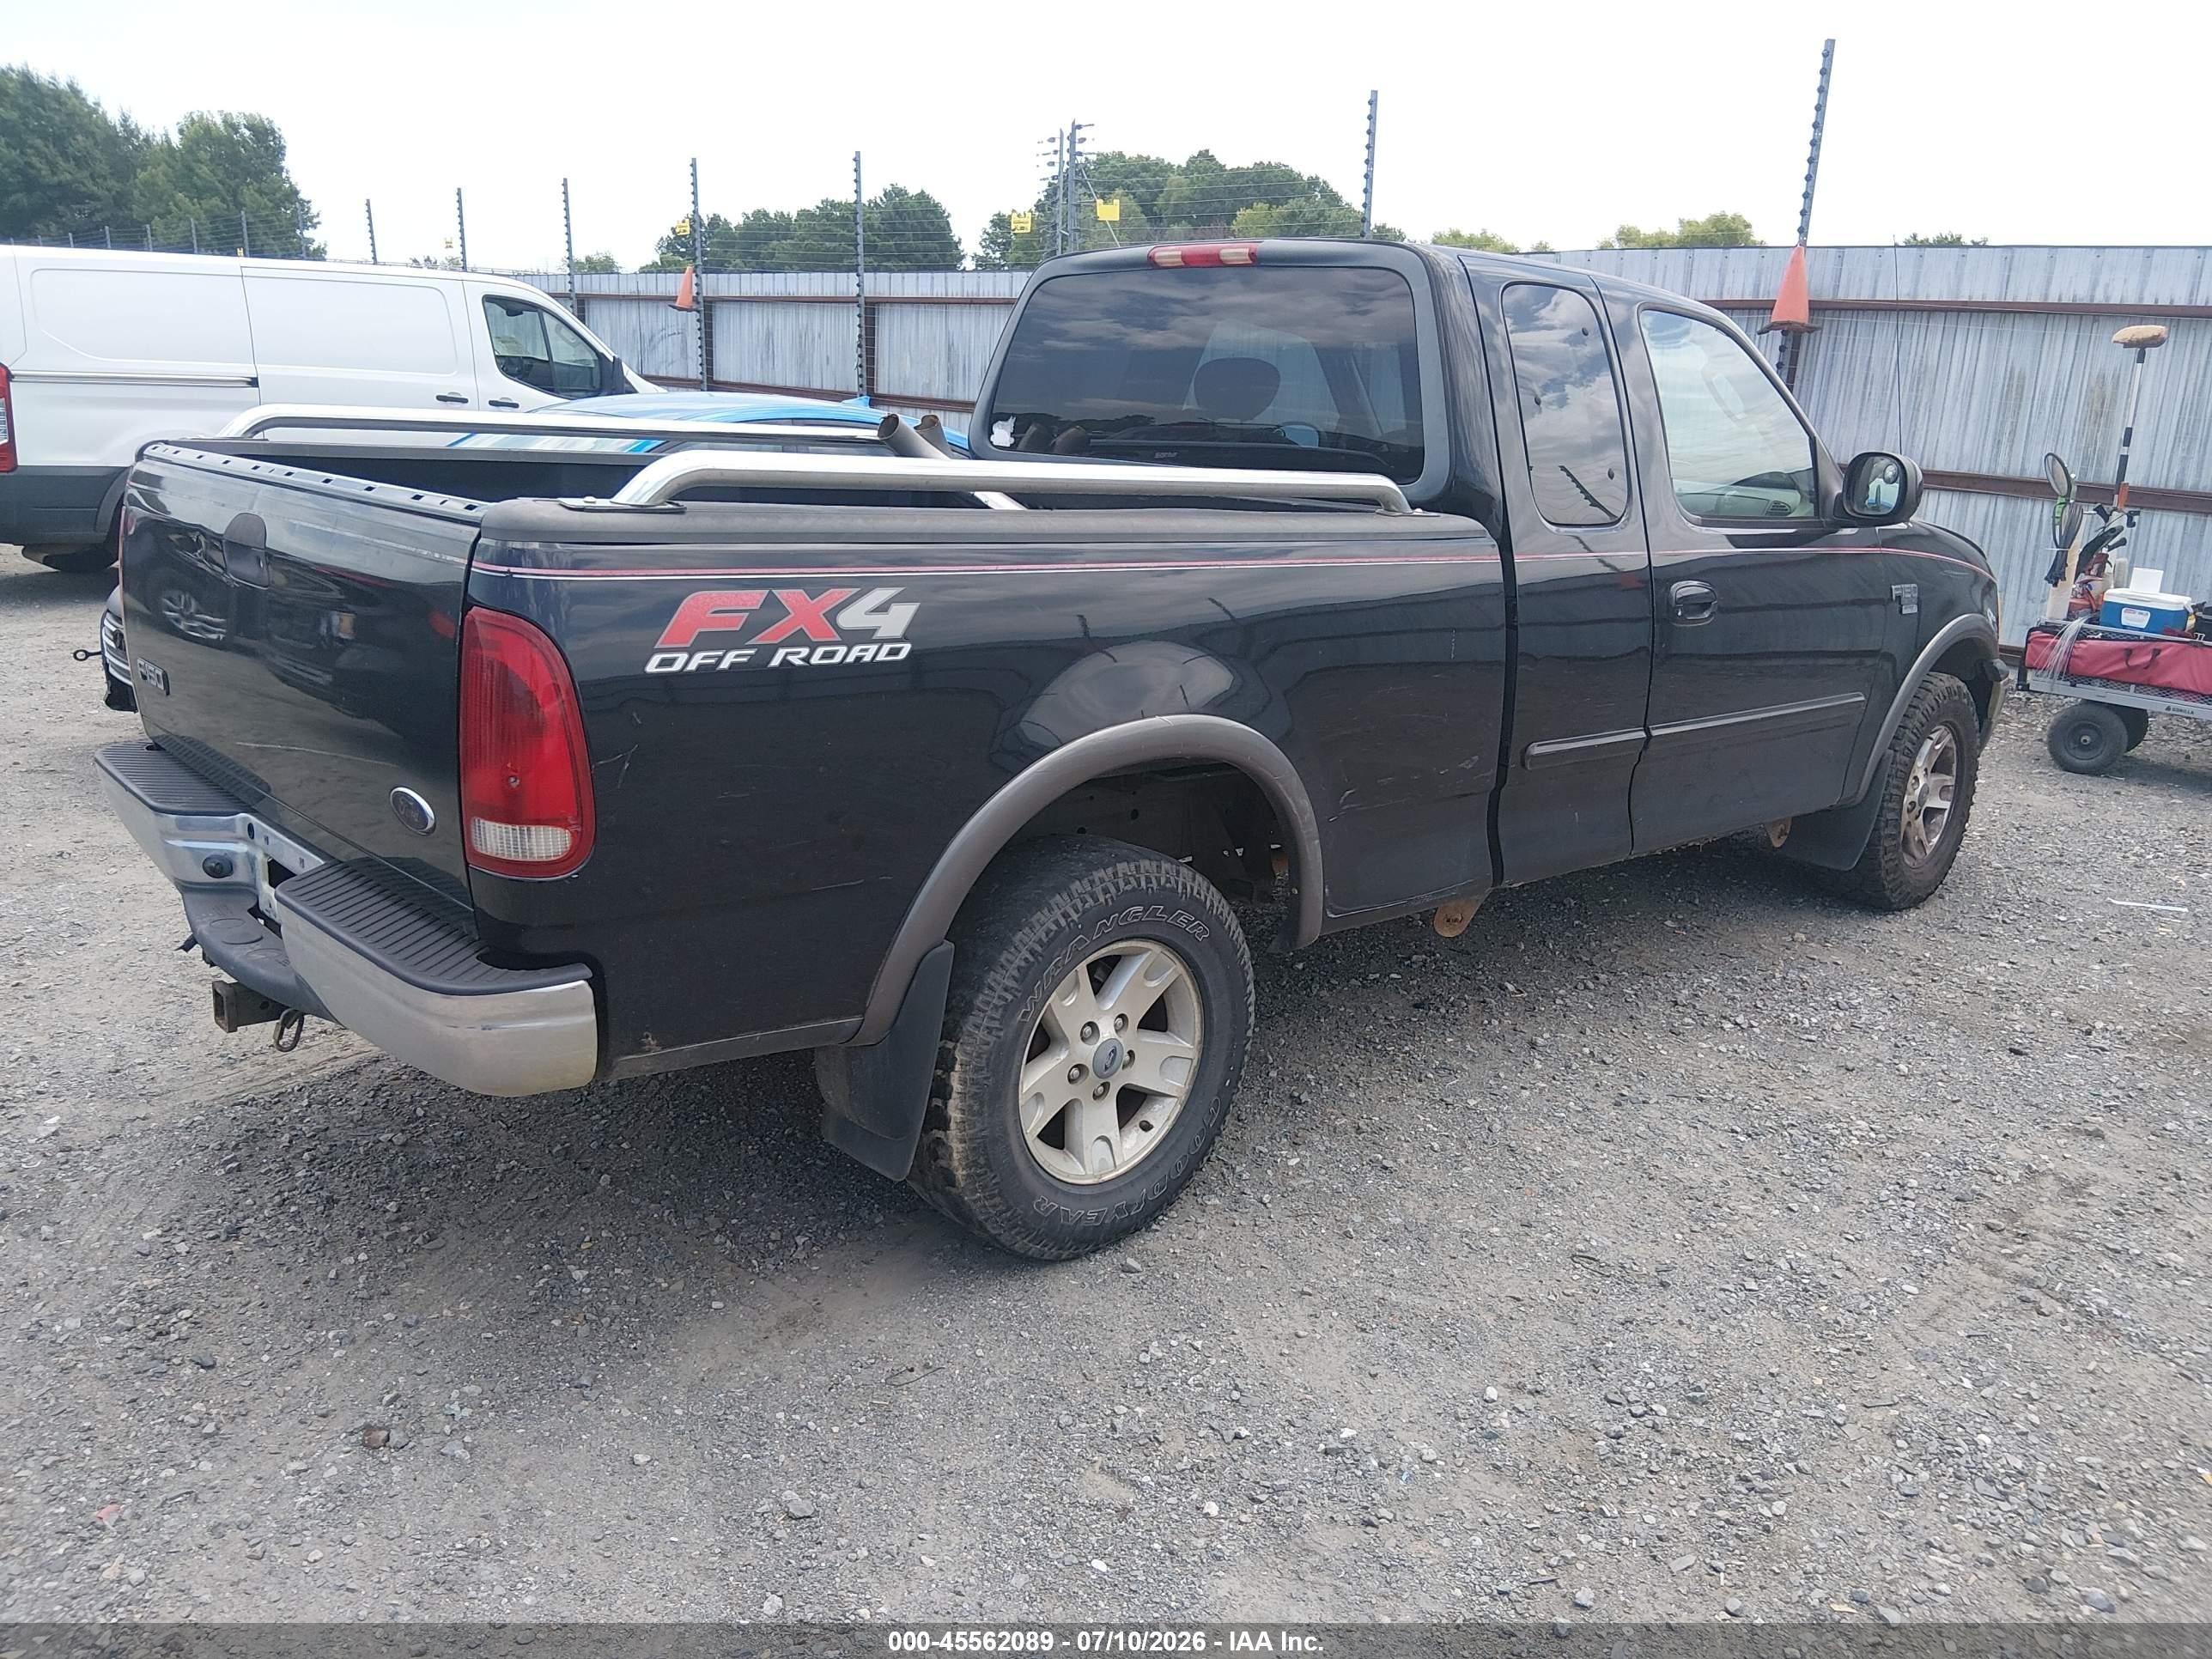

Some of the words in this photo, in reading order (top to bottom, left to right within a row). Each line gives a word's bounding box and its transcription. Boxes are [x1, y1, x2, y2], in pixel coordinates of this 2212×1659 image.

[645, 648, 757, 674] OFF
[768, 642, 912, 668] ROAD
[653, 587, 921, 648] FX4
[1018, 905, 1210, 1023] WRANGLER
[1033, 1096, 1221, 1226] GOODYEAR
